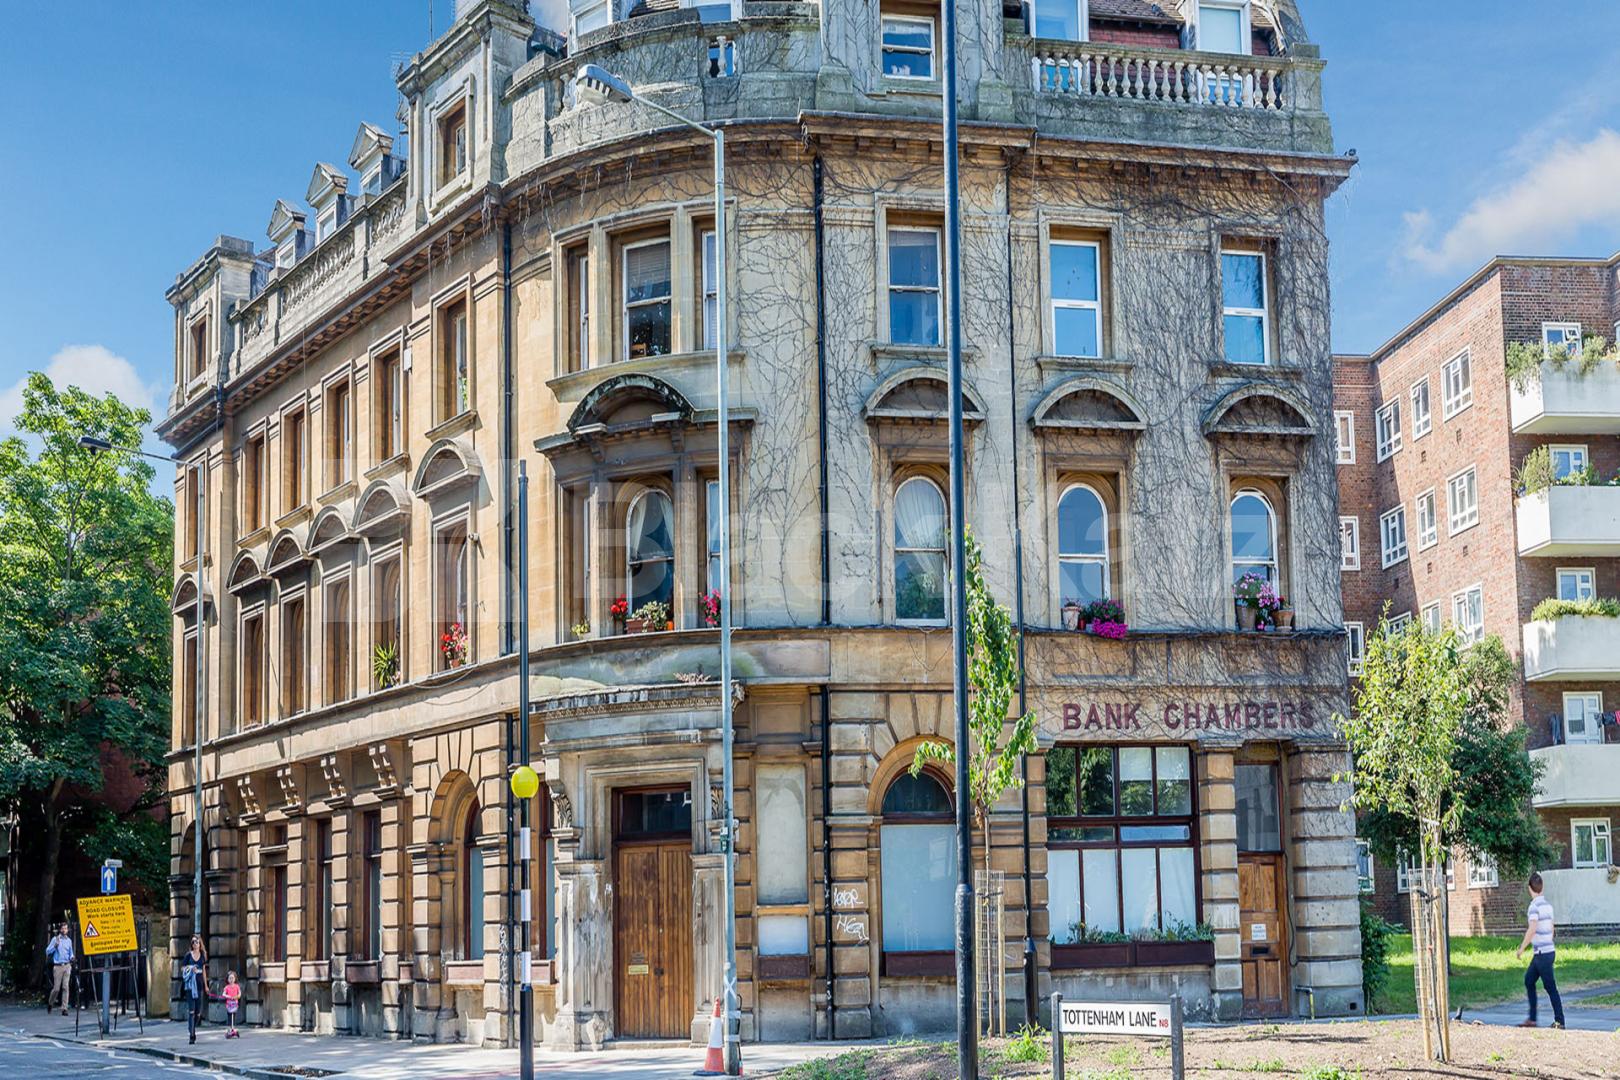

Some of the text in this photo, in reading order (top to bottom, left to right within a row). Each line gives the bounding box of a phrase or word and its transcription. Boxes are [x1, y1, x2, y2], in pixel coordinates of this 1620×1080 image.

[1063, 701, 1315, 730] BANK CHAMBERS
[1063, 1009, 1168, 1028] TOTTENHAM LANE N8
